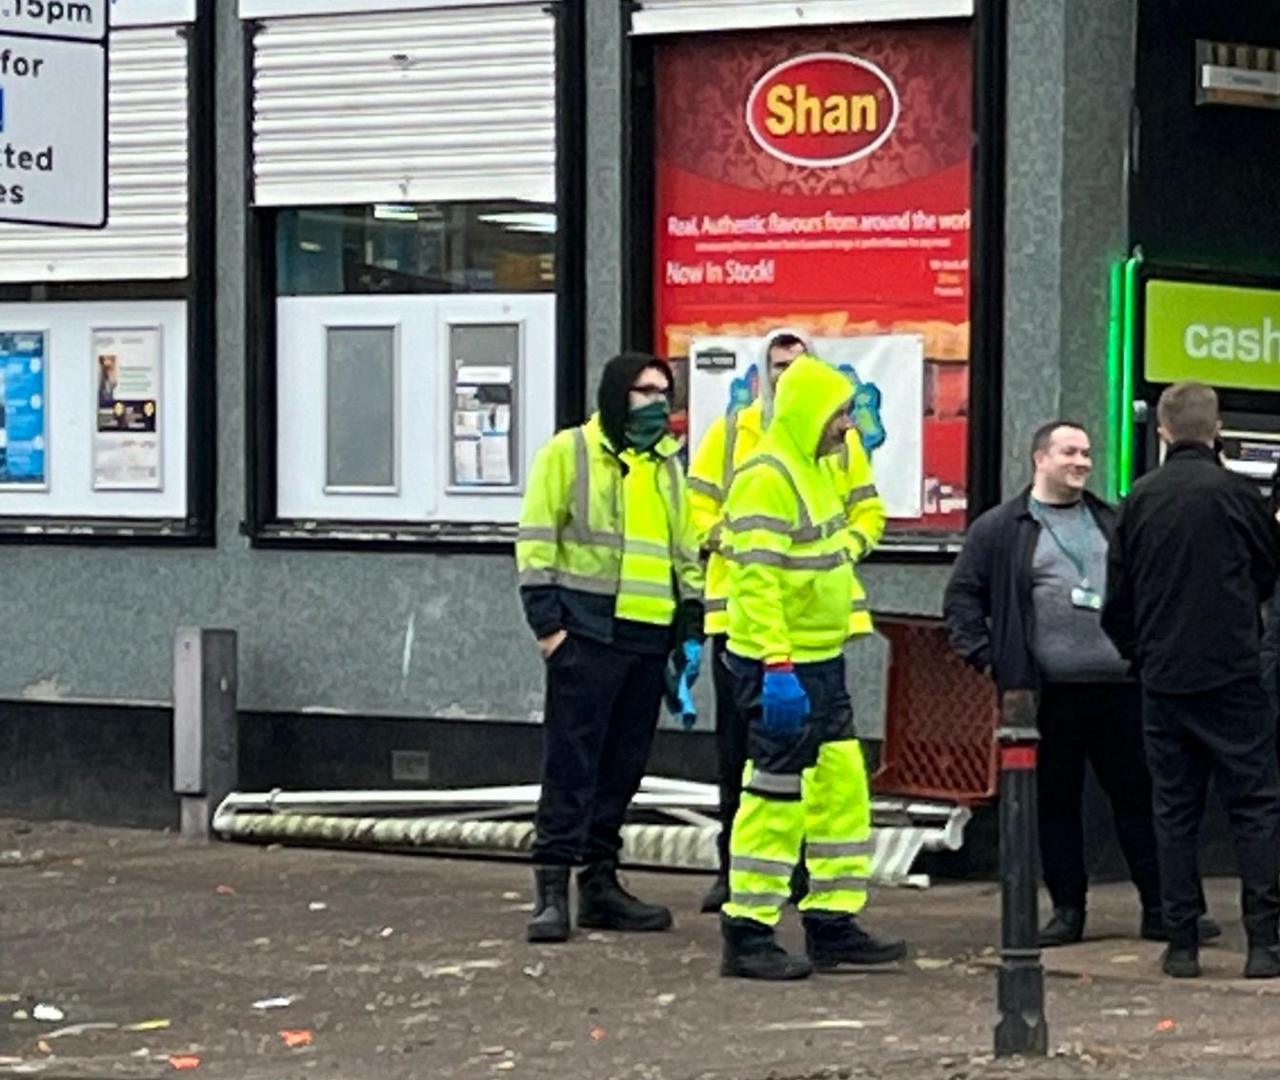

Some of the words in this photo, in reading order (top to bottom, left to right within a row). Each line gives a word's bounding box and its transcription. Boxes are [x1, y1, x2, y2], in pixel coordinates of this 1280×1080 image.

[0, 49, 44, 78] for
[765, 84, 877, 135] Shan
[824, 210, 858, 232] from
[861, 209, 910, 231] around
[911, 209, 936, 231] the
[666, 259, 704, 285] Now
